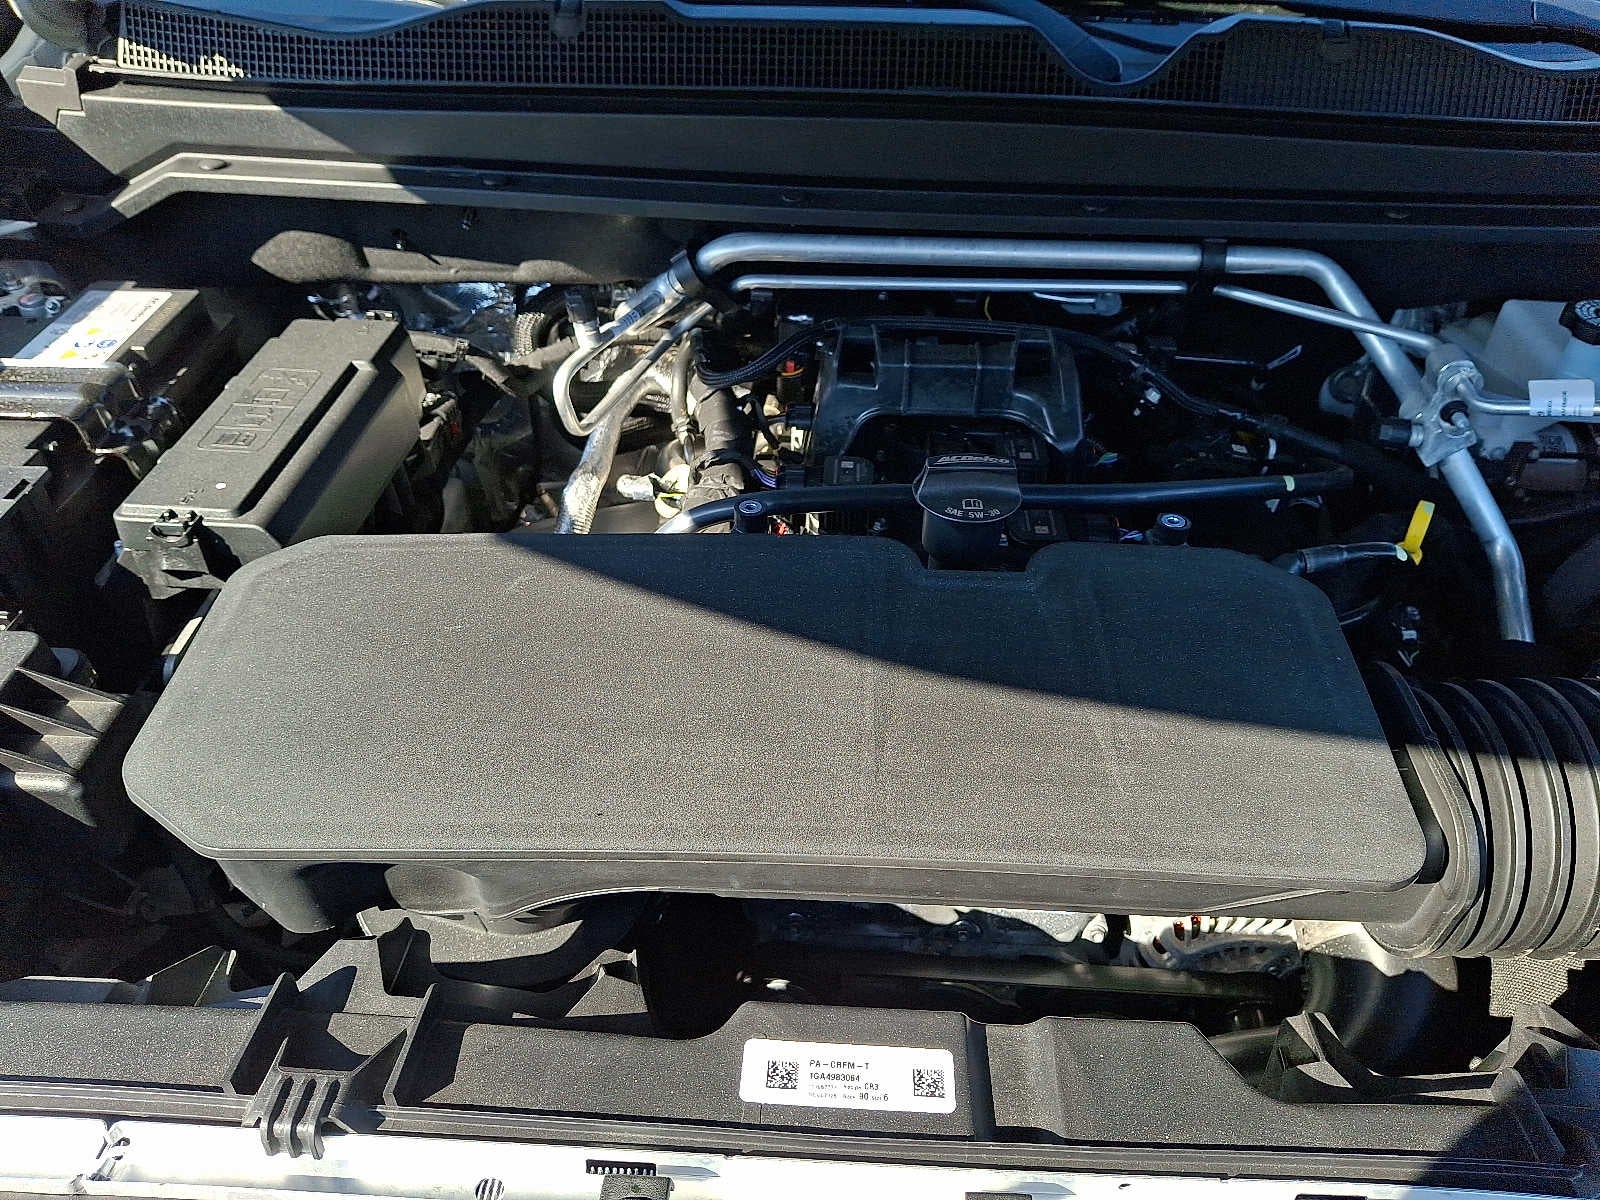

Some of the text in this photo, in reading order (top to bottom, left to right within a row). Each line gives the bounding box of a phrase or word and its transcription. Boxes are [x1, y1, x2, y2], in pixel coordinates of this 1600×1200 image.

[935, 455, 1010, 465] ACDelco
[945, 507, 1000, 518] SAE 5W-30
[883, 1093, 889, 1102] 6
